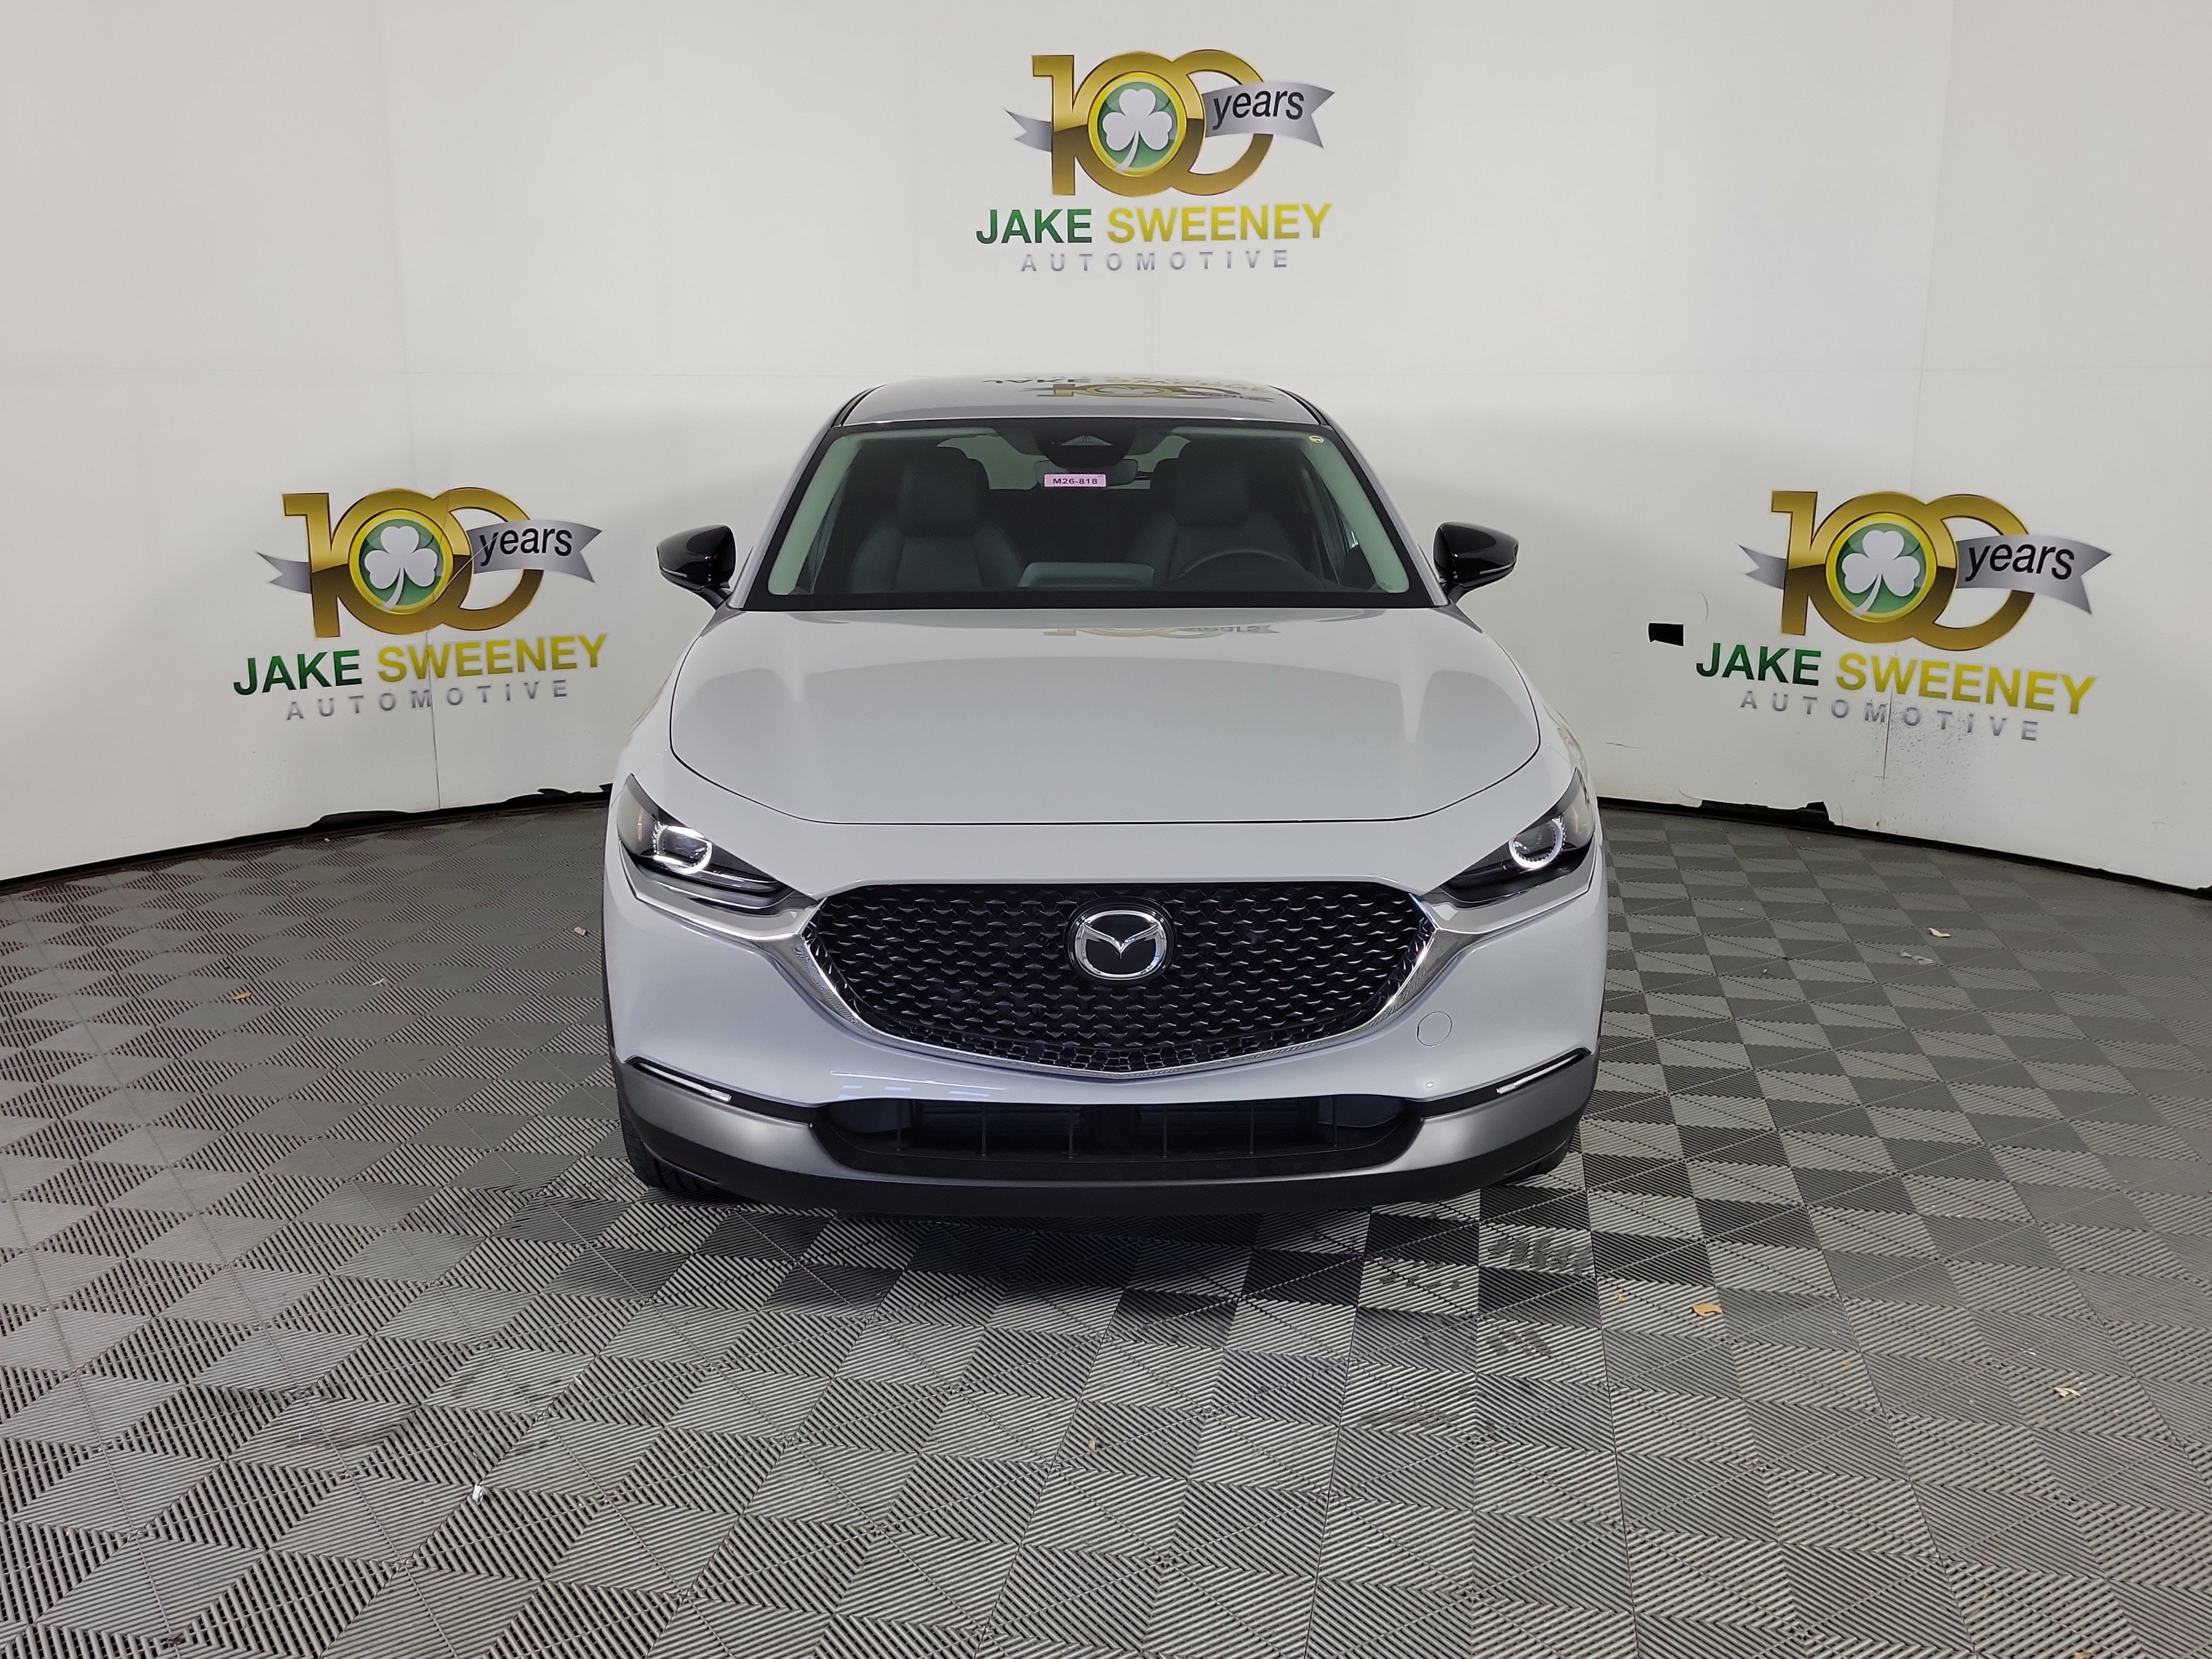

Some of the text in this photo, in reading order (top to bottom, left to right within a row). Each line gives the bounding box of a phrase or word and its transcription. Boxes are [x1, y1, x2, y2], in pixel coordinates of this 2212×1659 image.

[1032, 49, 1305, 197] 100 years
[976, 203, 1332, 244] JAKE SWEENEY
[1021, 250, 1288, 272] AUTOMOTIVE
[282, 487, 573, 637] 100 years
[1771, 490, 2075, 651] 100 years
[233, 634, 607, 695] JAKE SWEENEY
[1696, 642, 2098, 715] JAKE SWEENEY
[286, 680, 567, 721] AUTOMOTIVE
[1740, 690, 2038, 742] AUTOMOTIVE
